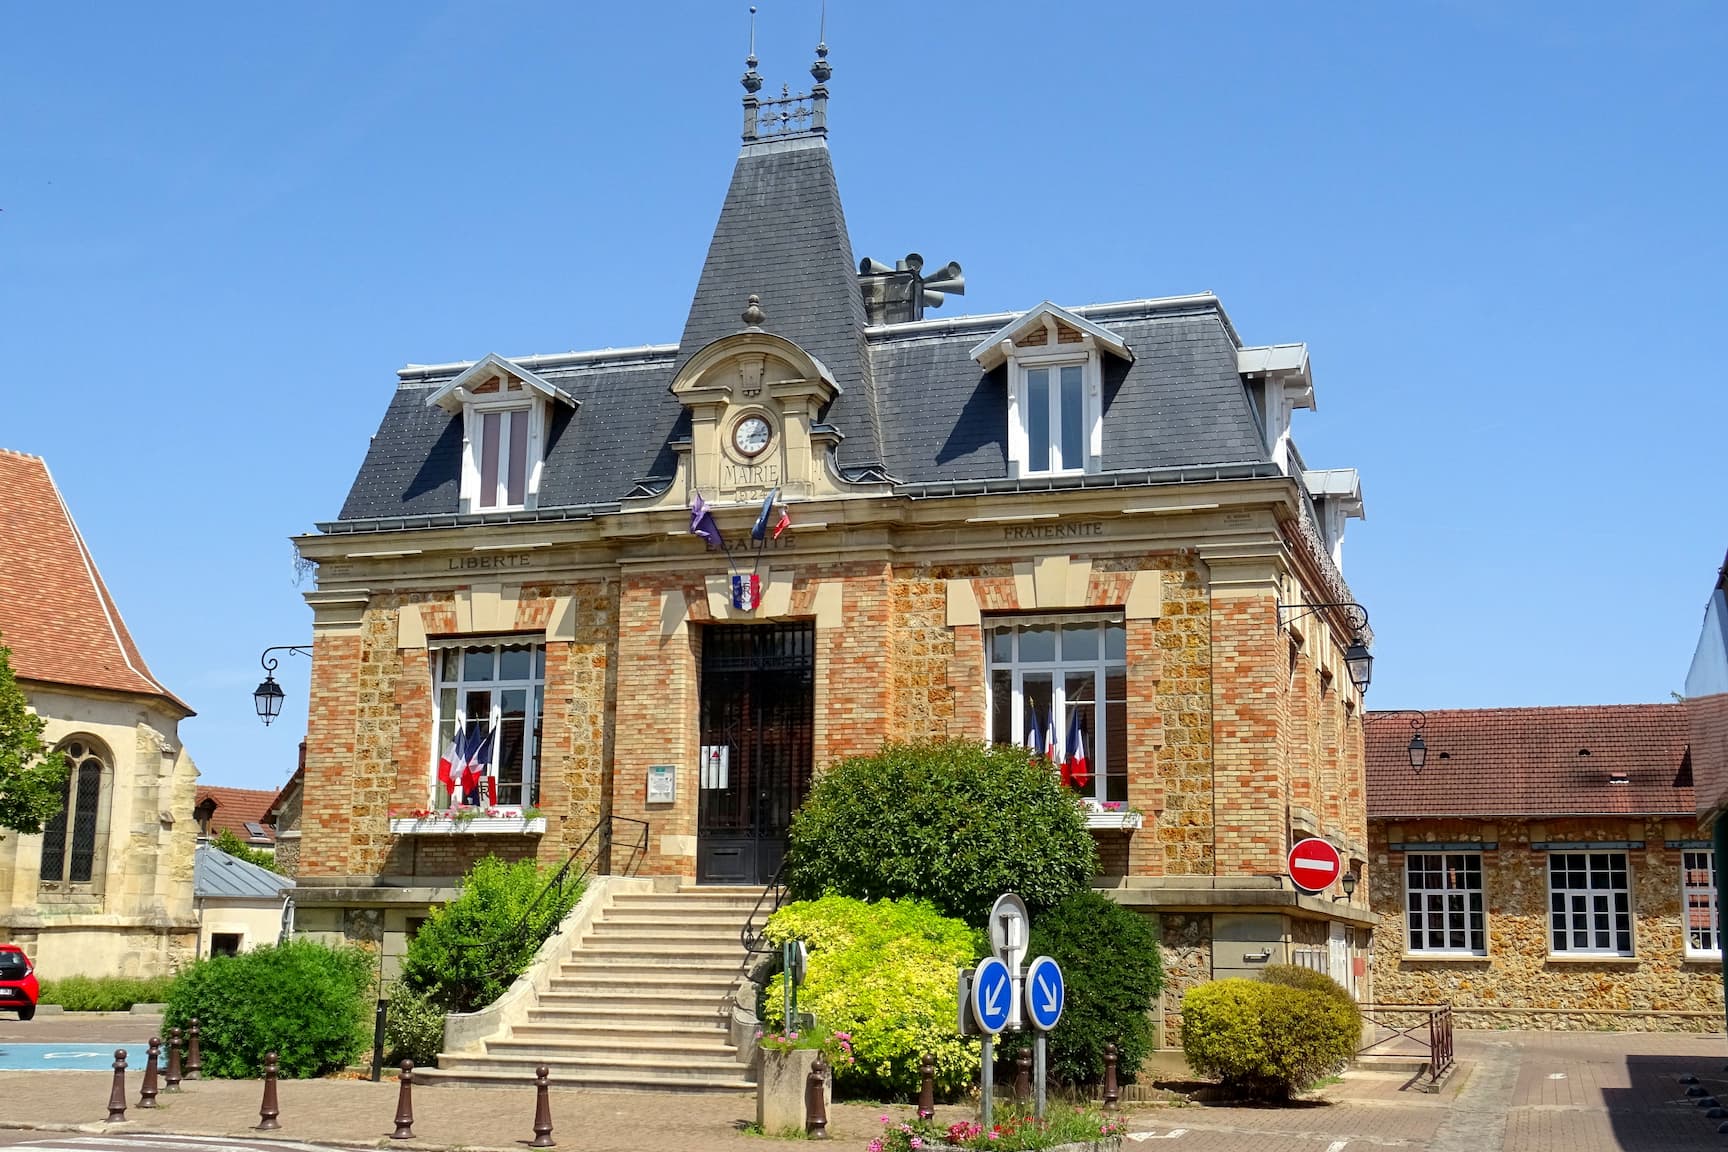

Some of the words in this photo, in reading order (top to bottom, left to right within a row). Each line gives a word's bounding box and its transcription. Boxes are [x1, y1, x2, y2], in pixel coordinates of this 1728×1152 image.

[724, 465, 779, 485] MAIRIE
[1003, 521, 1105, 540] FRATERNITE
[448, 553, 532, 570] LIBERTE
